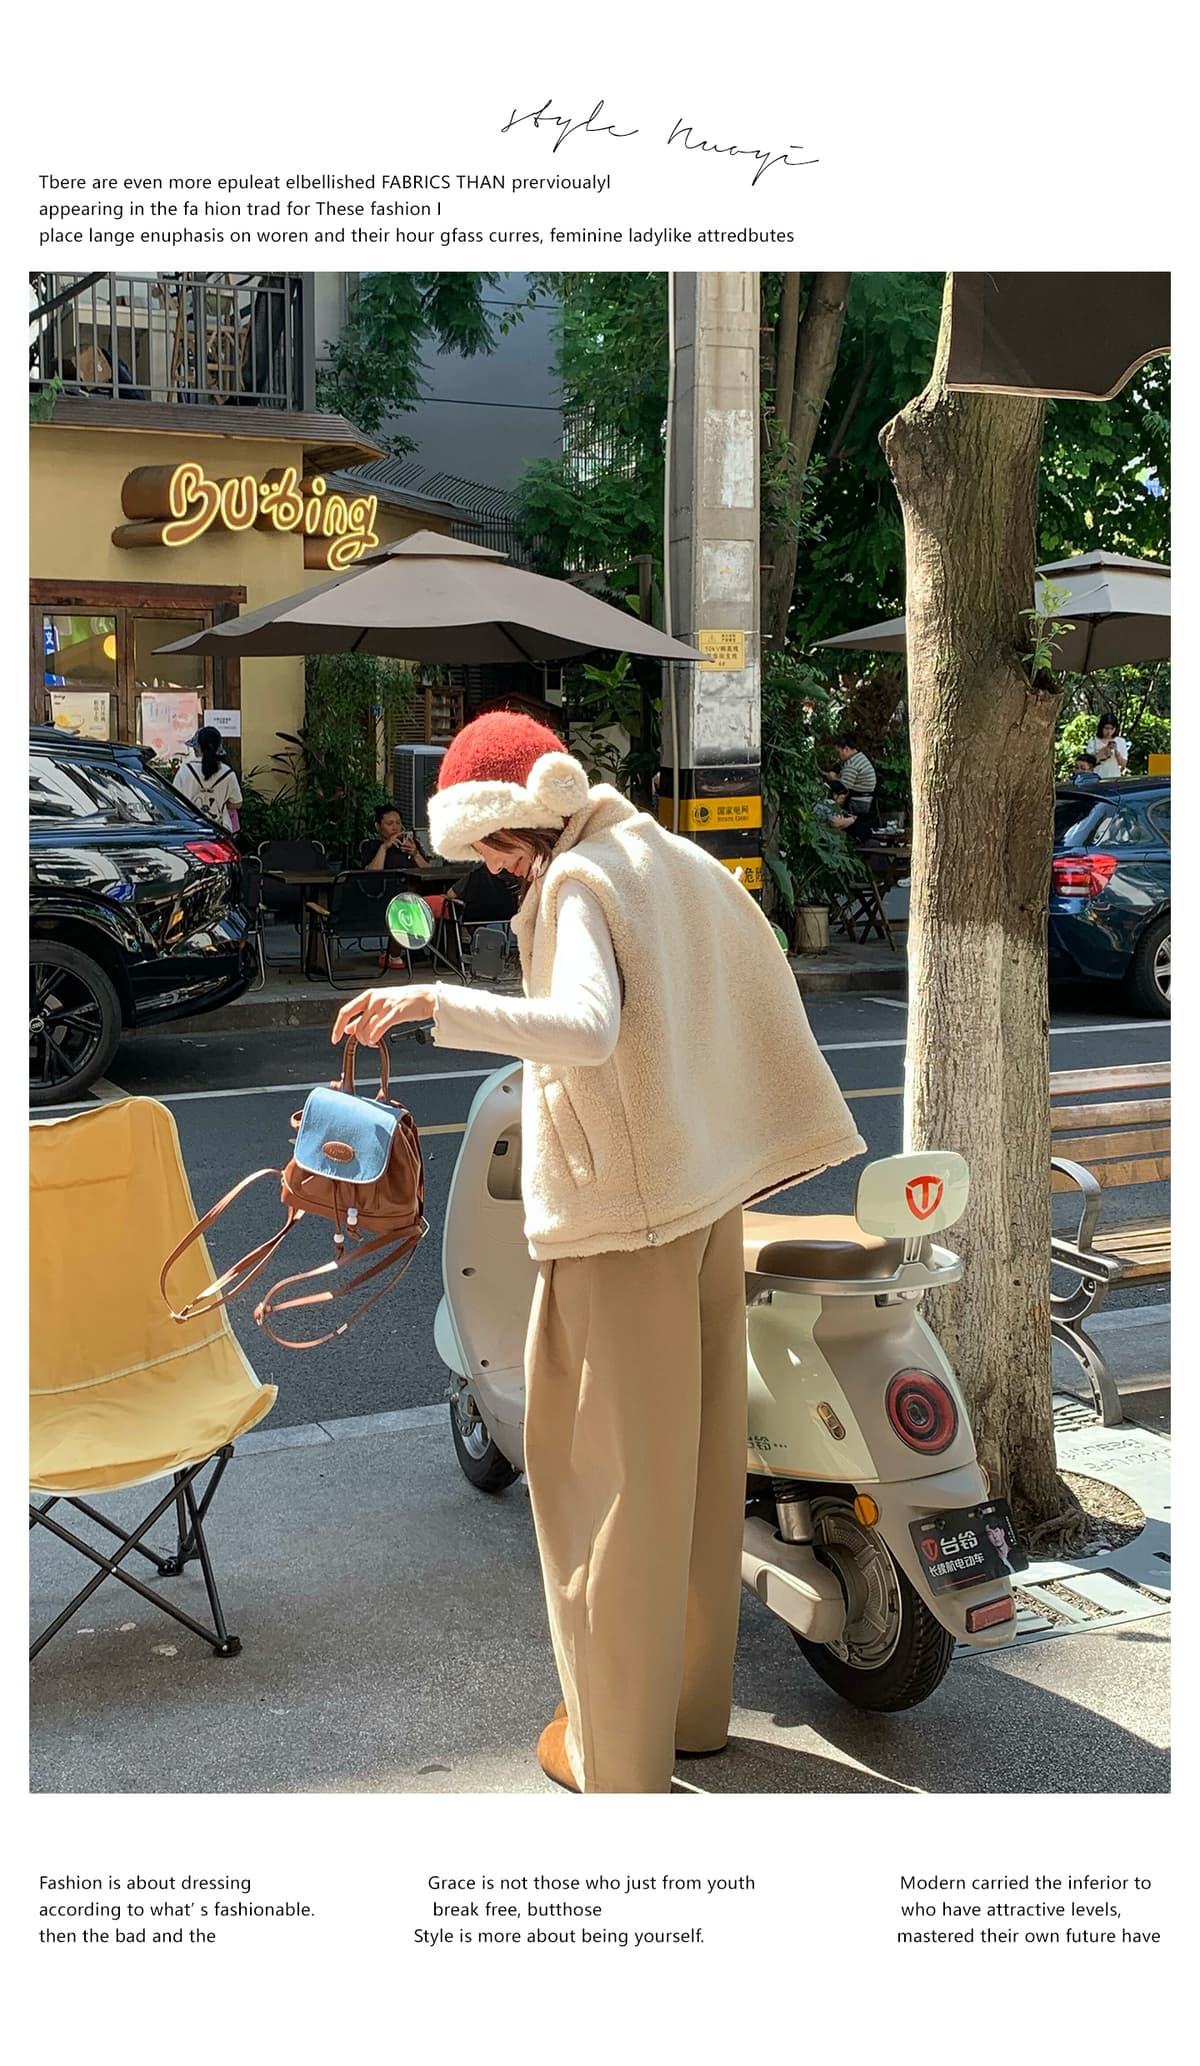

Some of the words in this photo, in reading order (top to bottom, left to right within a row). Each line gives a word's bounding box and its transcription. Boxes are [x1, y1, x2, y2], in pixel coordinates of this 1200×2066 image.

[717, 805, 749, 816] 国家电网
[940, 1530, 978, 1556] 台铃
[928, 1552, 985, 1577] 长续航电动车
